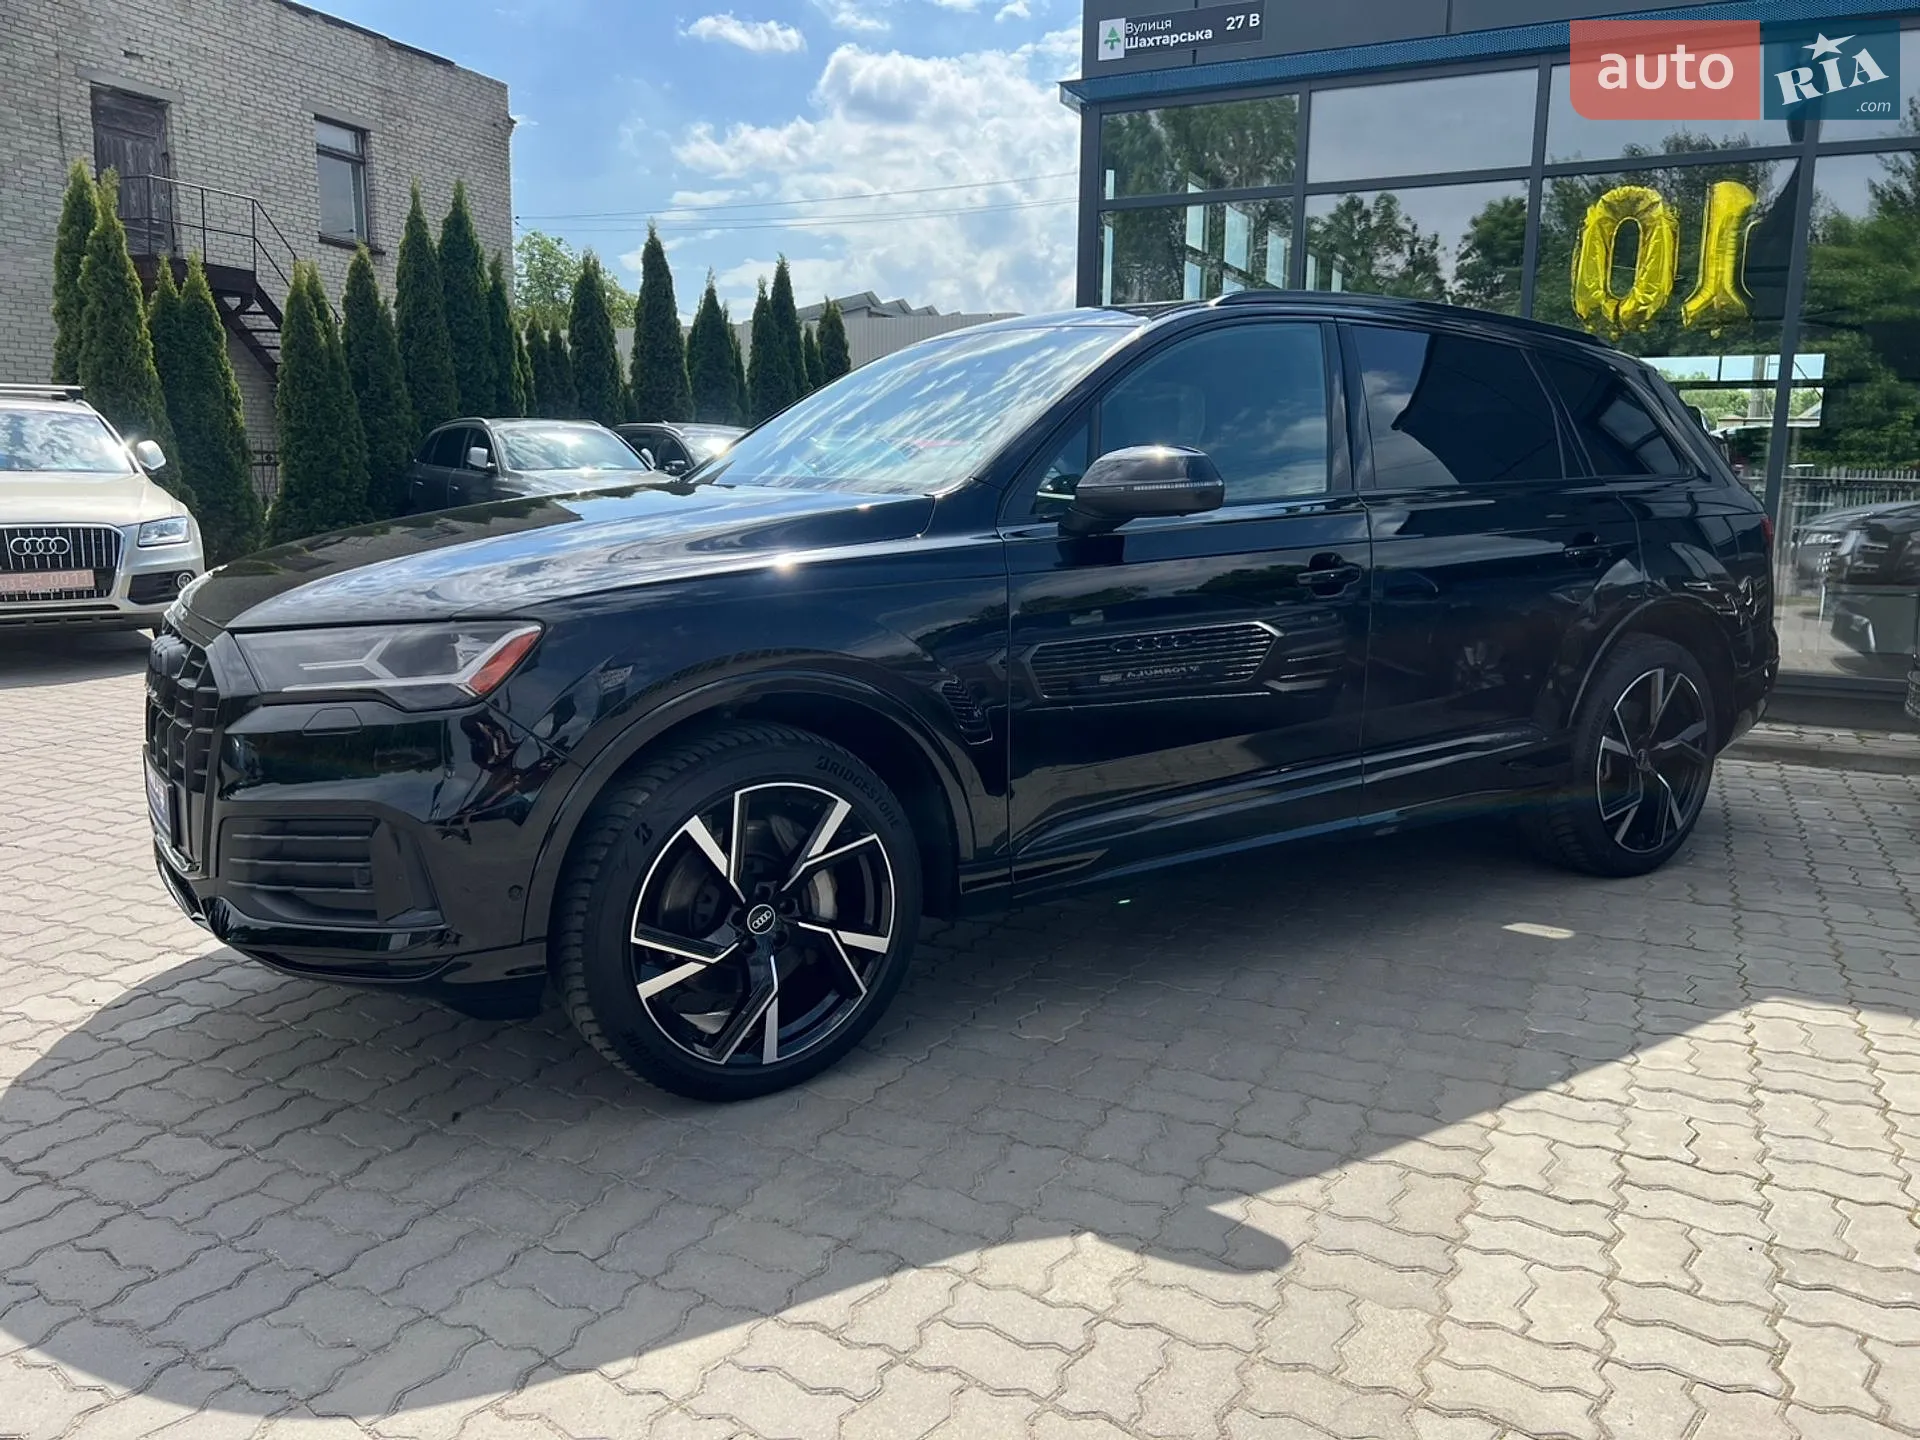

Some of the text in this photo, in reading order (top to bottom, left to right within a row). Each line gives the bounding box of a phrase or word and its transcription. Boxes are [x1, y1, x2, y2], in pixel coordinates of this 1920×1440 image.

[1125, 19, 1172, 35] Вулиця
[1226, 15, 1245, 31] 27
[1125, 29, 1213, 49] Шахтарська
[814, 755, 899, 830] BRIDGESTONE
